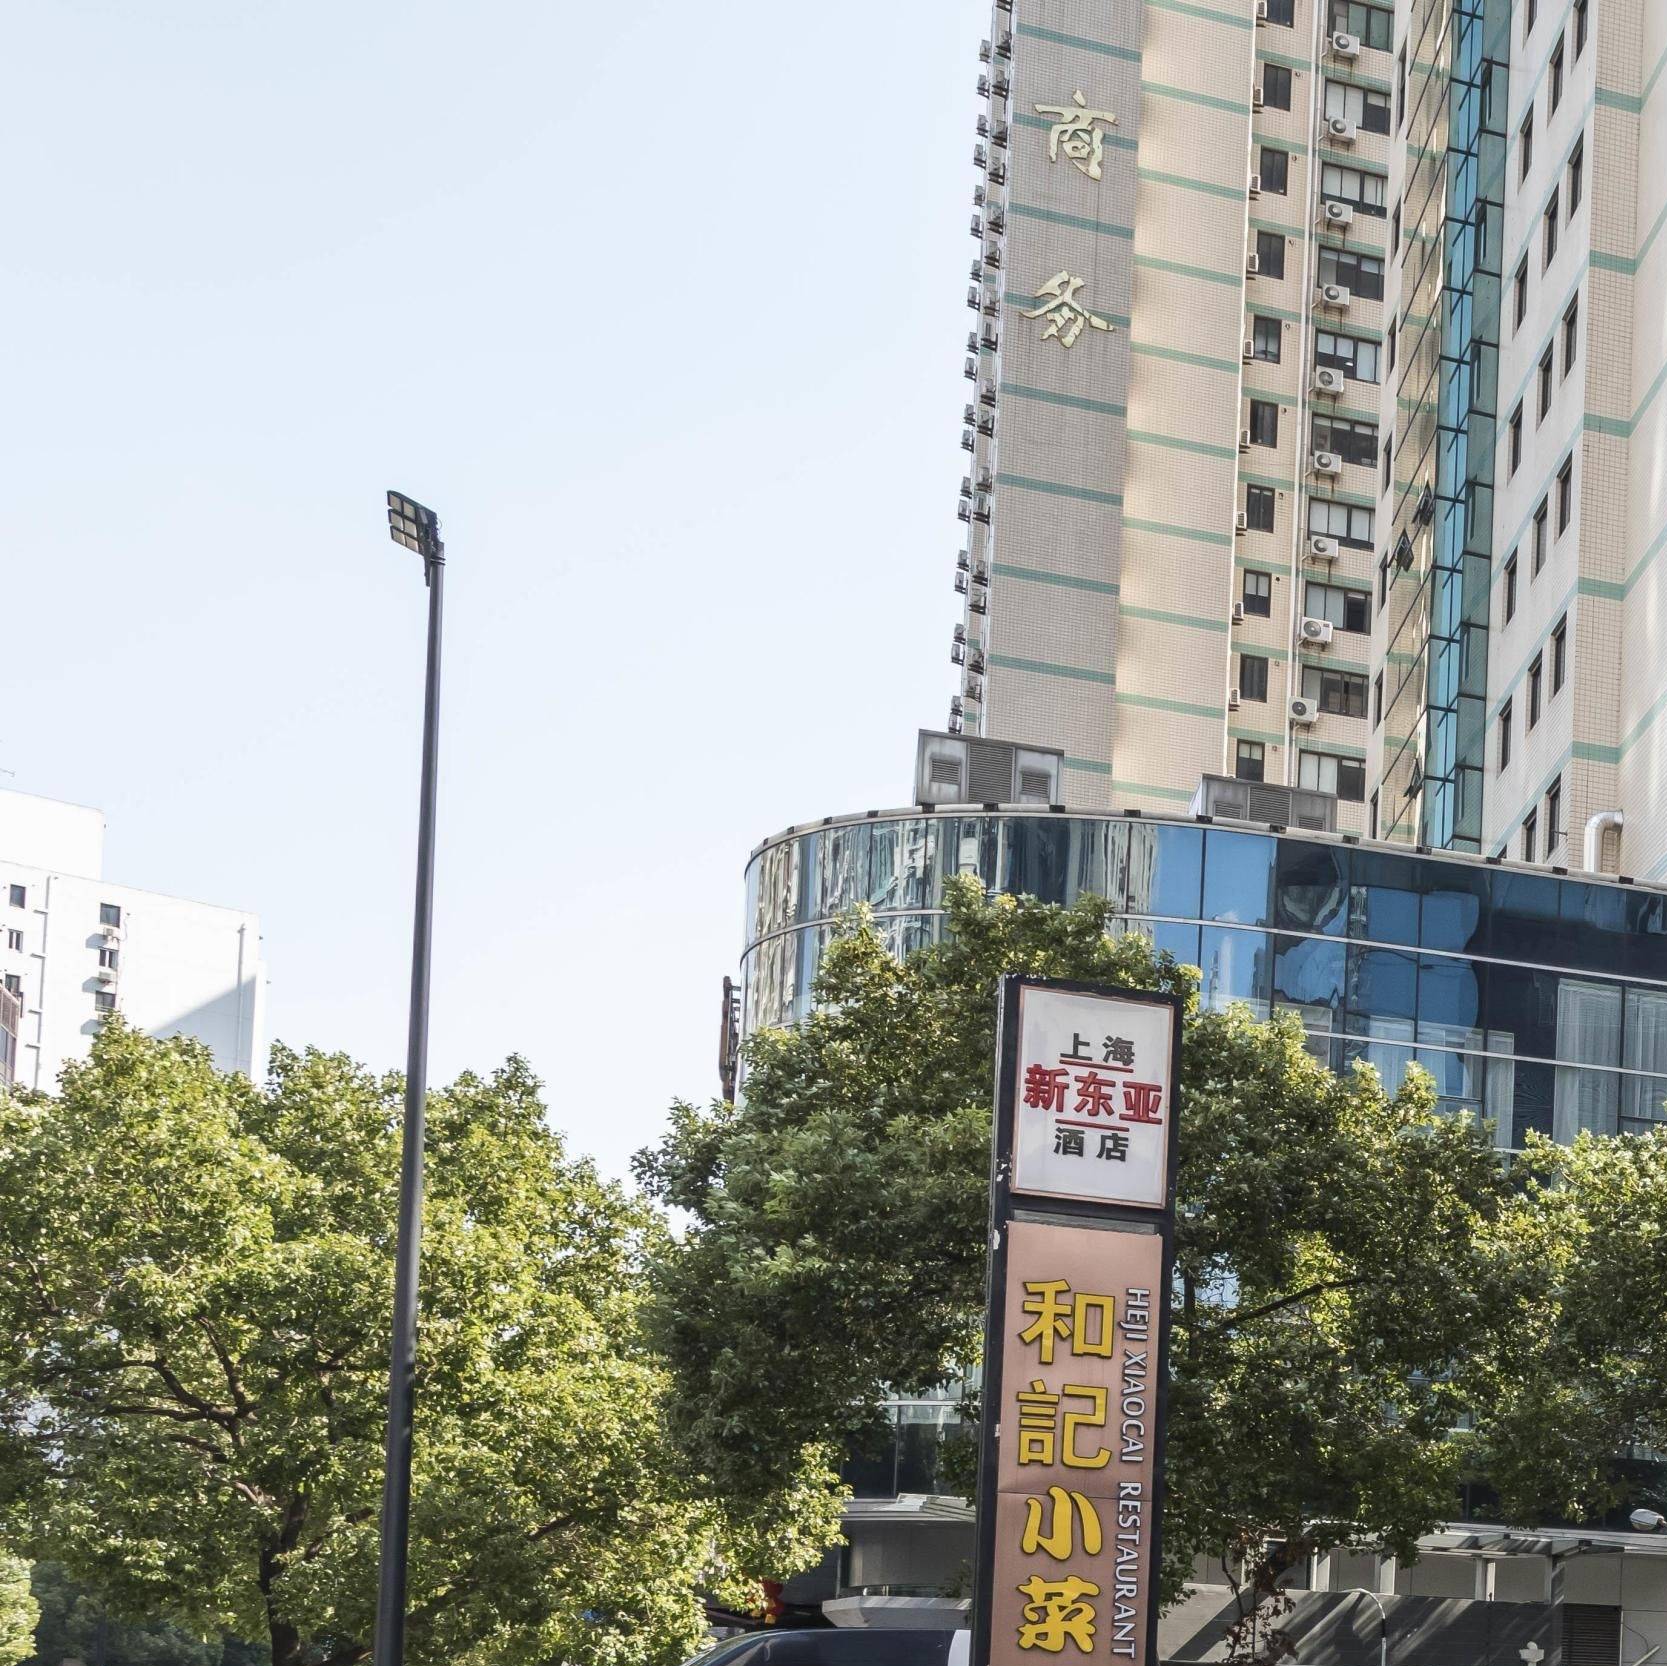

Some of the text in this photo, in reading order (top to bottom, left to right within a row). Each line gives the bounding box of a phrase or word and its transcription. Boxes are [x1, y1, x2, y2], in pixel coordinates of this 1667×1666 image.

[1018, 89, 1118, 350] 商务
[1023, 1063, 1163, 1125] 新东亚
[1060, 1032, 1135, 1067] 上海
[1053, 1126, 1130, 1163] 酒店
[1016, 1278, 1117, 1655] 和記小菜
[1111, 1287, 1151, 1660] HEJI XIAOCAI RESTAURANT
